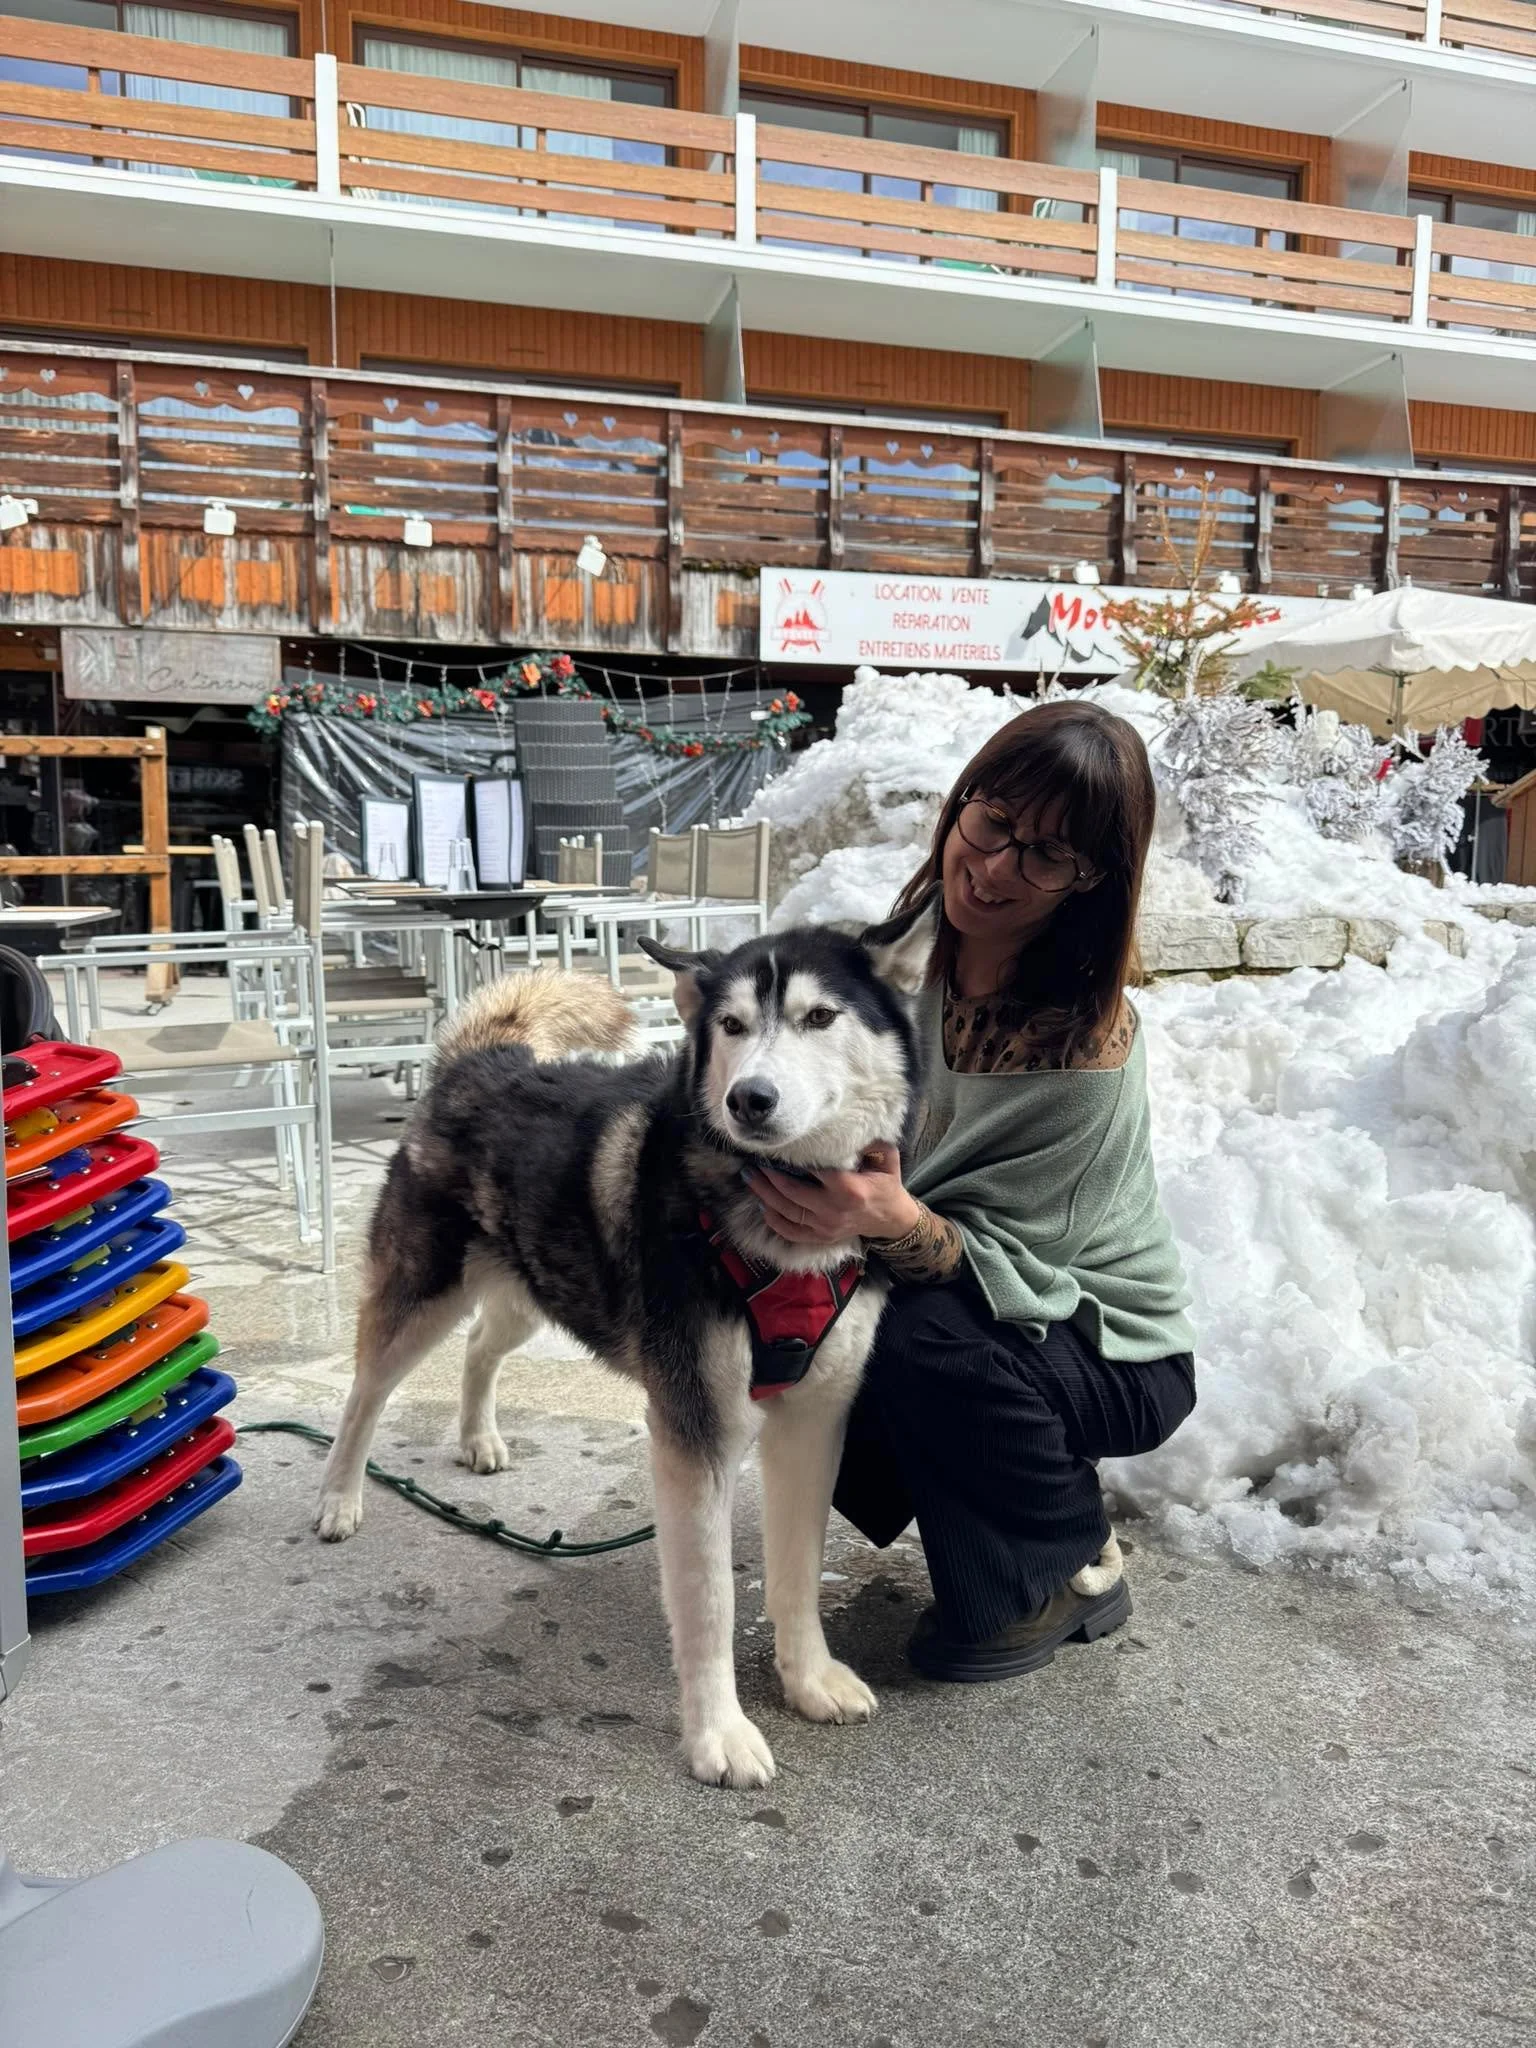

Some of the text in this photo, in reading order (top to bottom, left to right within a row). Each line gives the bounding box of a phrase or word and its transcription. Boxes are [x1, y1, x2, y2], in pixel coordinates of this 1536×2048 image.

[875, 583, 990, 604] LOCATION VENTE
[859, 640, 931, 659] ENTRETIENS
